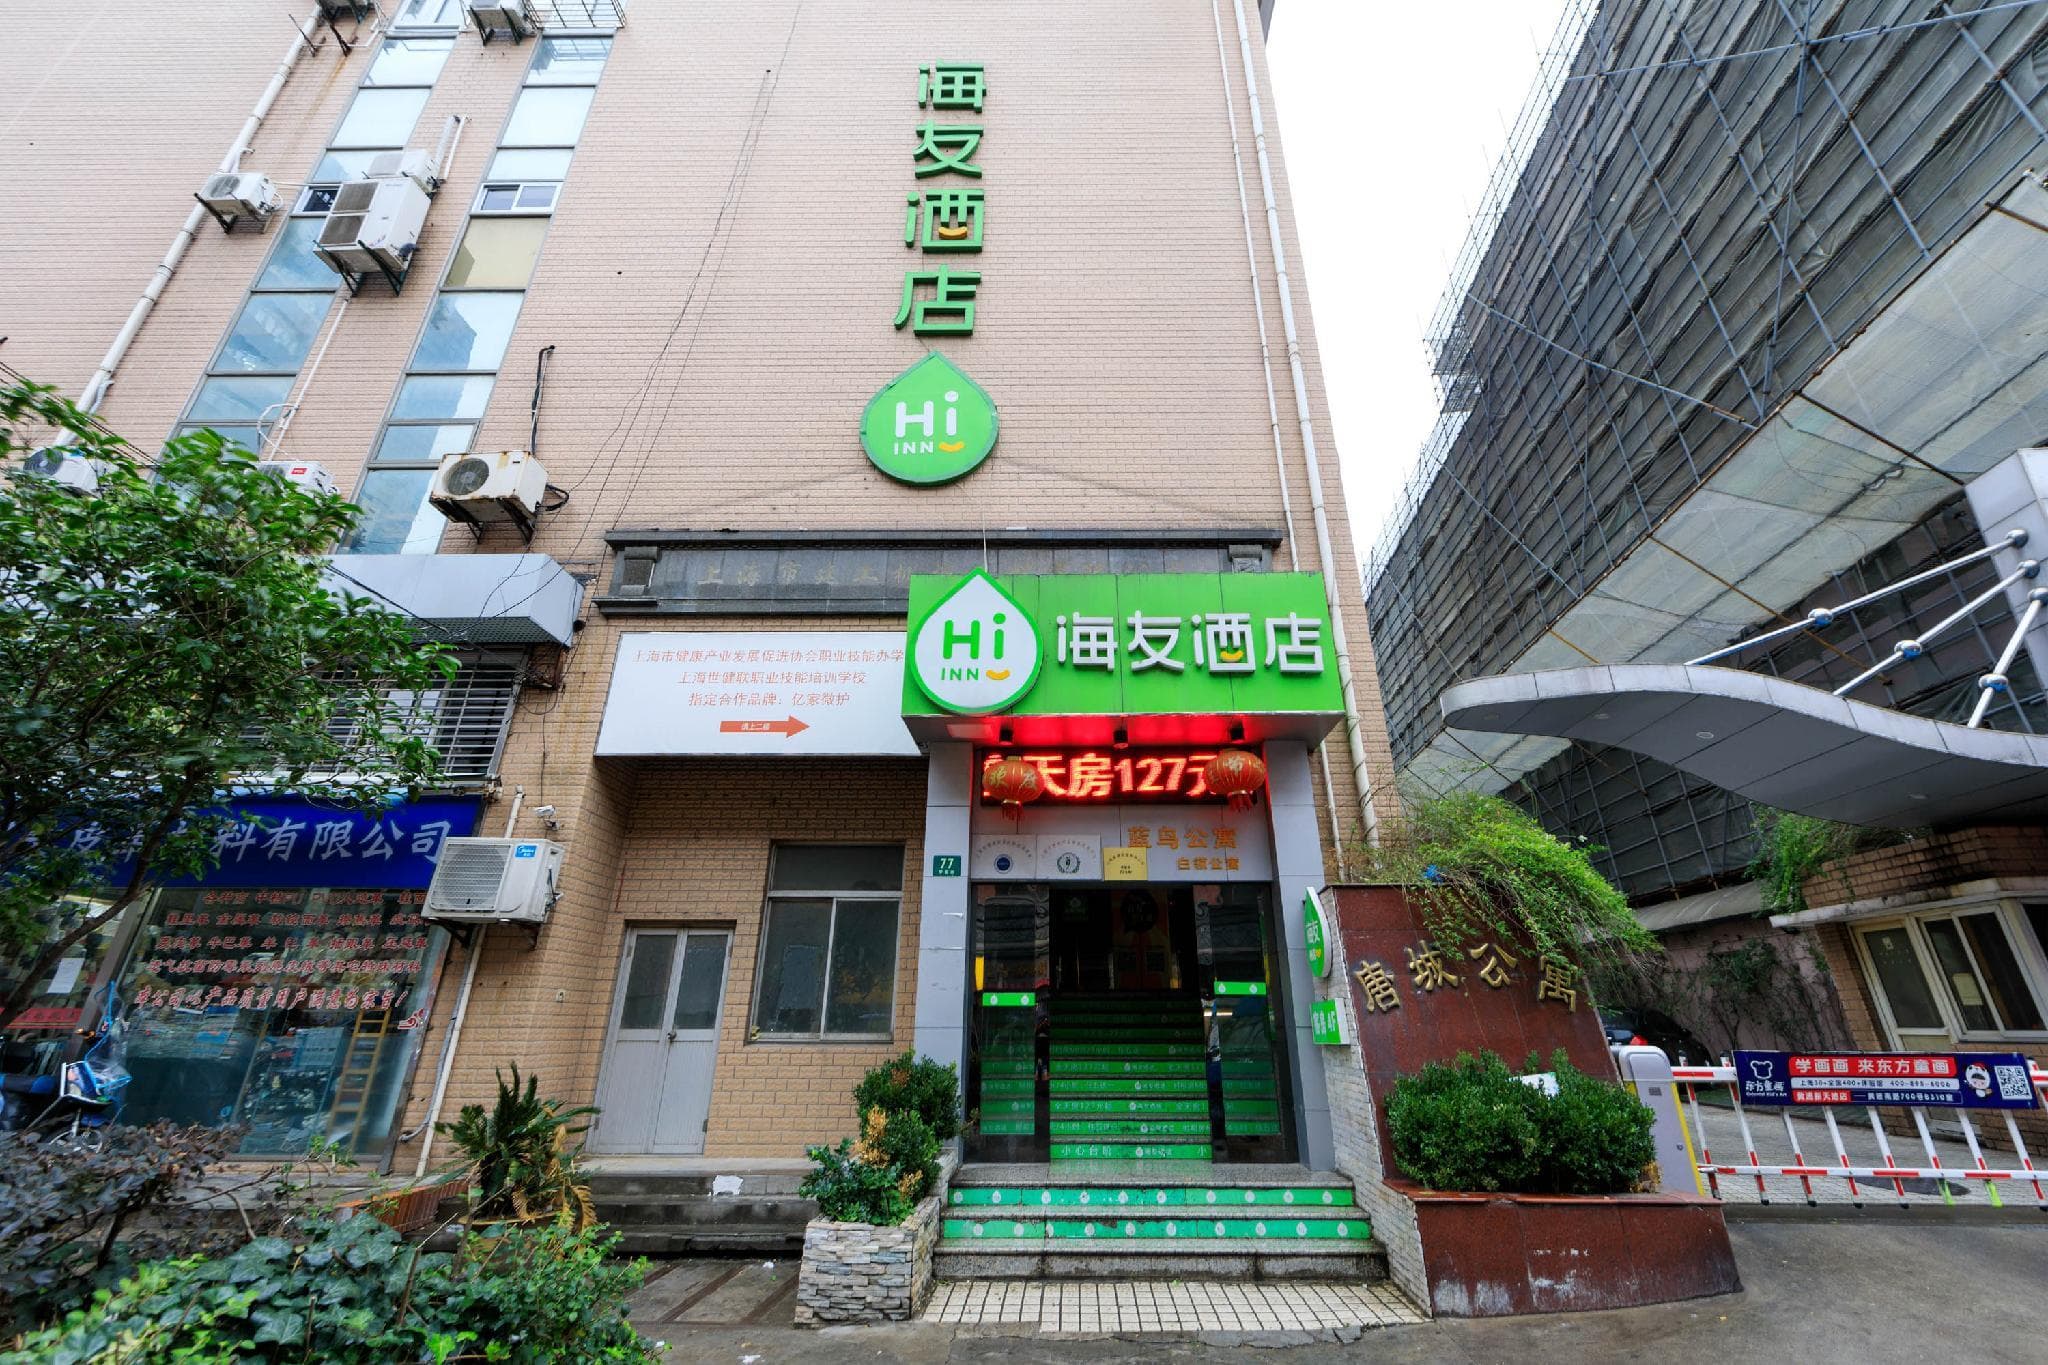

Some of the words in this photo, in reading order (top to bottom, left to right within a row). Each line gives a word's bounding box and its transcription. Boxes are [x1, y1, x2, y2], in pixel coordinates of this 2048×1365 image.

[894, 58, 987, 336] 海友酒店
[895, 391, 959, 438] Hi
[893, 441, 934, 456] INN
[942, 613, 1006, 660] Hi
[1056, 610, 1325, 674] 海友酒店
[940, 667, 979, 681] INN
[984, 753, 1218, 798] 天房127元
[1128, 826, 1237, 849] 蓝鸟公寓
[940, 857, 955, 869] 77
[1177, 857, 1240, 871] 白领公寓
[1795, 1058, 1849, 1073] 学画画
[1857, 1058, 1950, 1074] 来东方童画
[1061, 1145, 1112, 1157] 小心台阶
